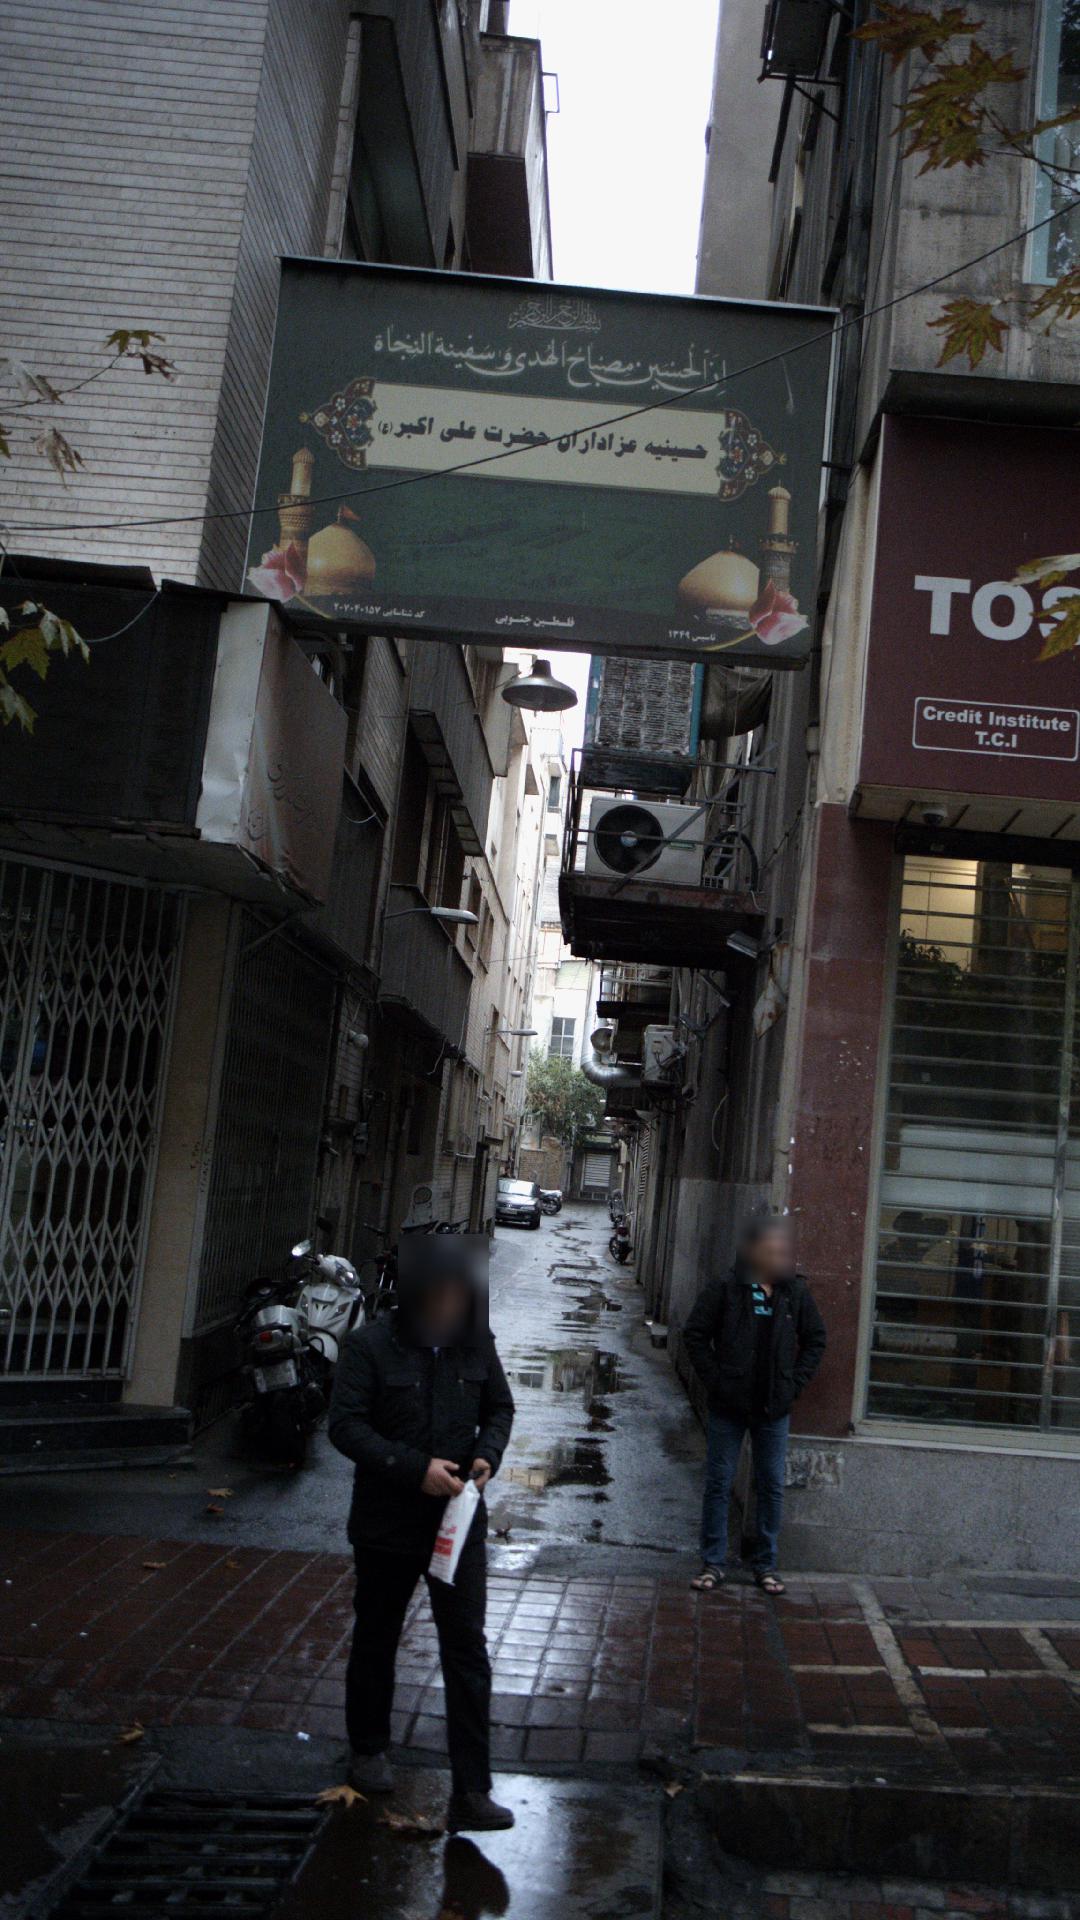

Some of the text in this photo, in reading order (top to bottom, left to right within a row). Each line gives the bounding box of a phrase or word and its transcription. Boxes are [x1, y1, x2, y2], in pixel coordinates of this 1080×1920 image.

[394, 416, 435, 439] اکبر
[440, 420, 477, 442] علی
[483, 425, 550, 448] حضرت
[557, 430, 638, 458] عزاداران
[644, 439, 709, 462] حسینیه
[495, 614, 576, 628] فلسطین جنوبی
[922, 705, 1072, 733] Credit Institute
[974, 731, 1018, 748] T.C.I
